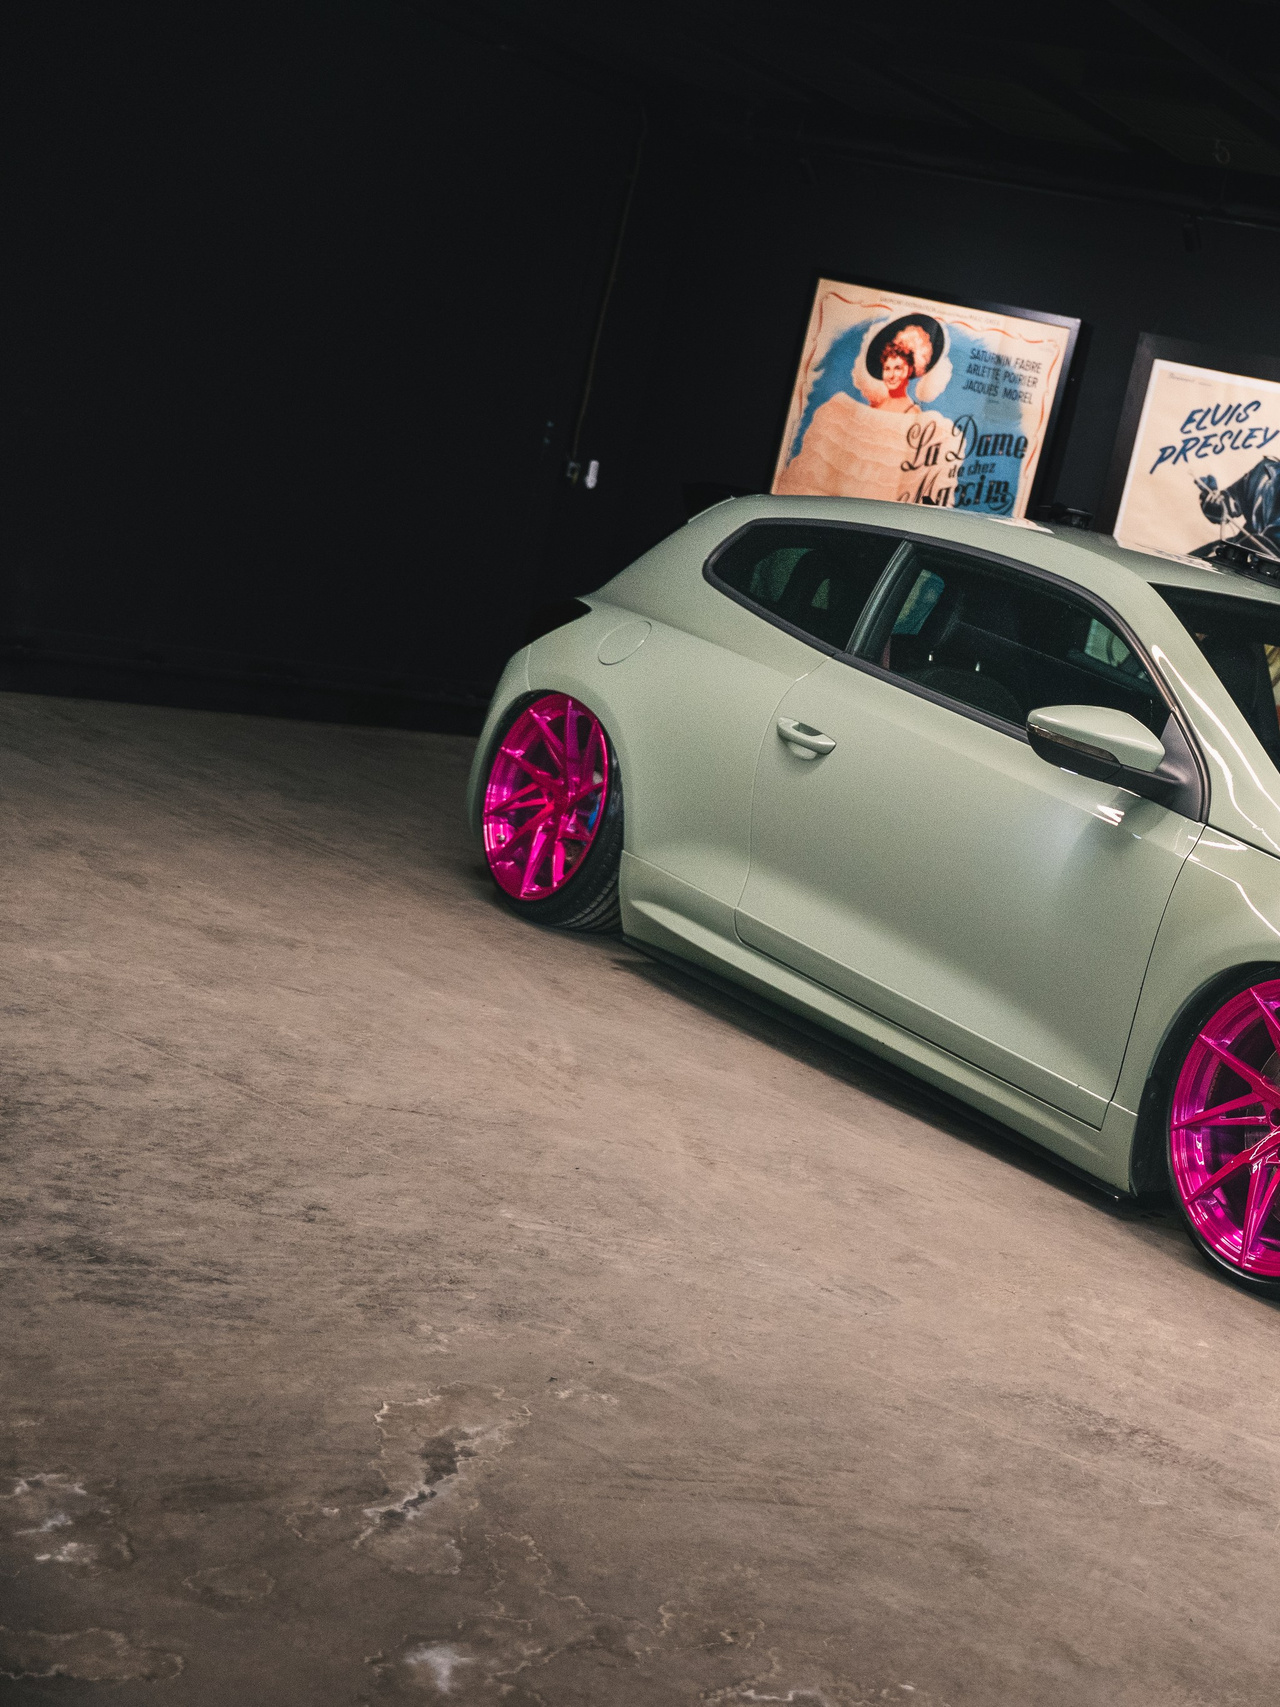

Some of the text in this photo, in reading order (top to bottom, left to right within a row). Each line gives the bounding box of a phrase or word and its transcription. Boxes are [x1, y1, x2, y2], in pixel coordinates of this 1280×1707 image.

[966, 362, 1039, 388] ARLETTE POIRIER
[969, 347, 1043, 374] SATURNIN FABRE
[962, 380, 1033, 405] JACQUES MOREL
[1180, 400, 1261, 434] ELVIS
[900, 413, 1029, 472] La Dame
[1149, 426, 1280, 475] PRESLEY
[948, 460, 997, 478] de chez
[897, 469, 1015, 516] Maxim
